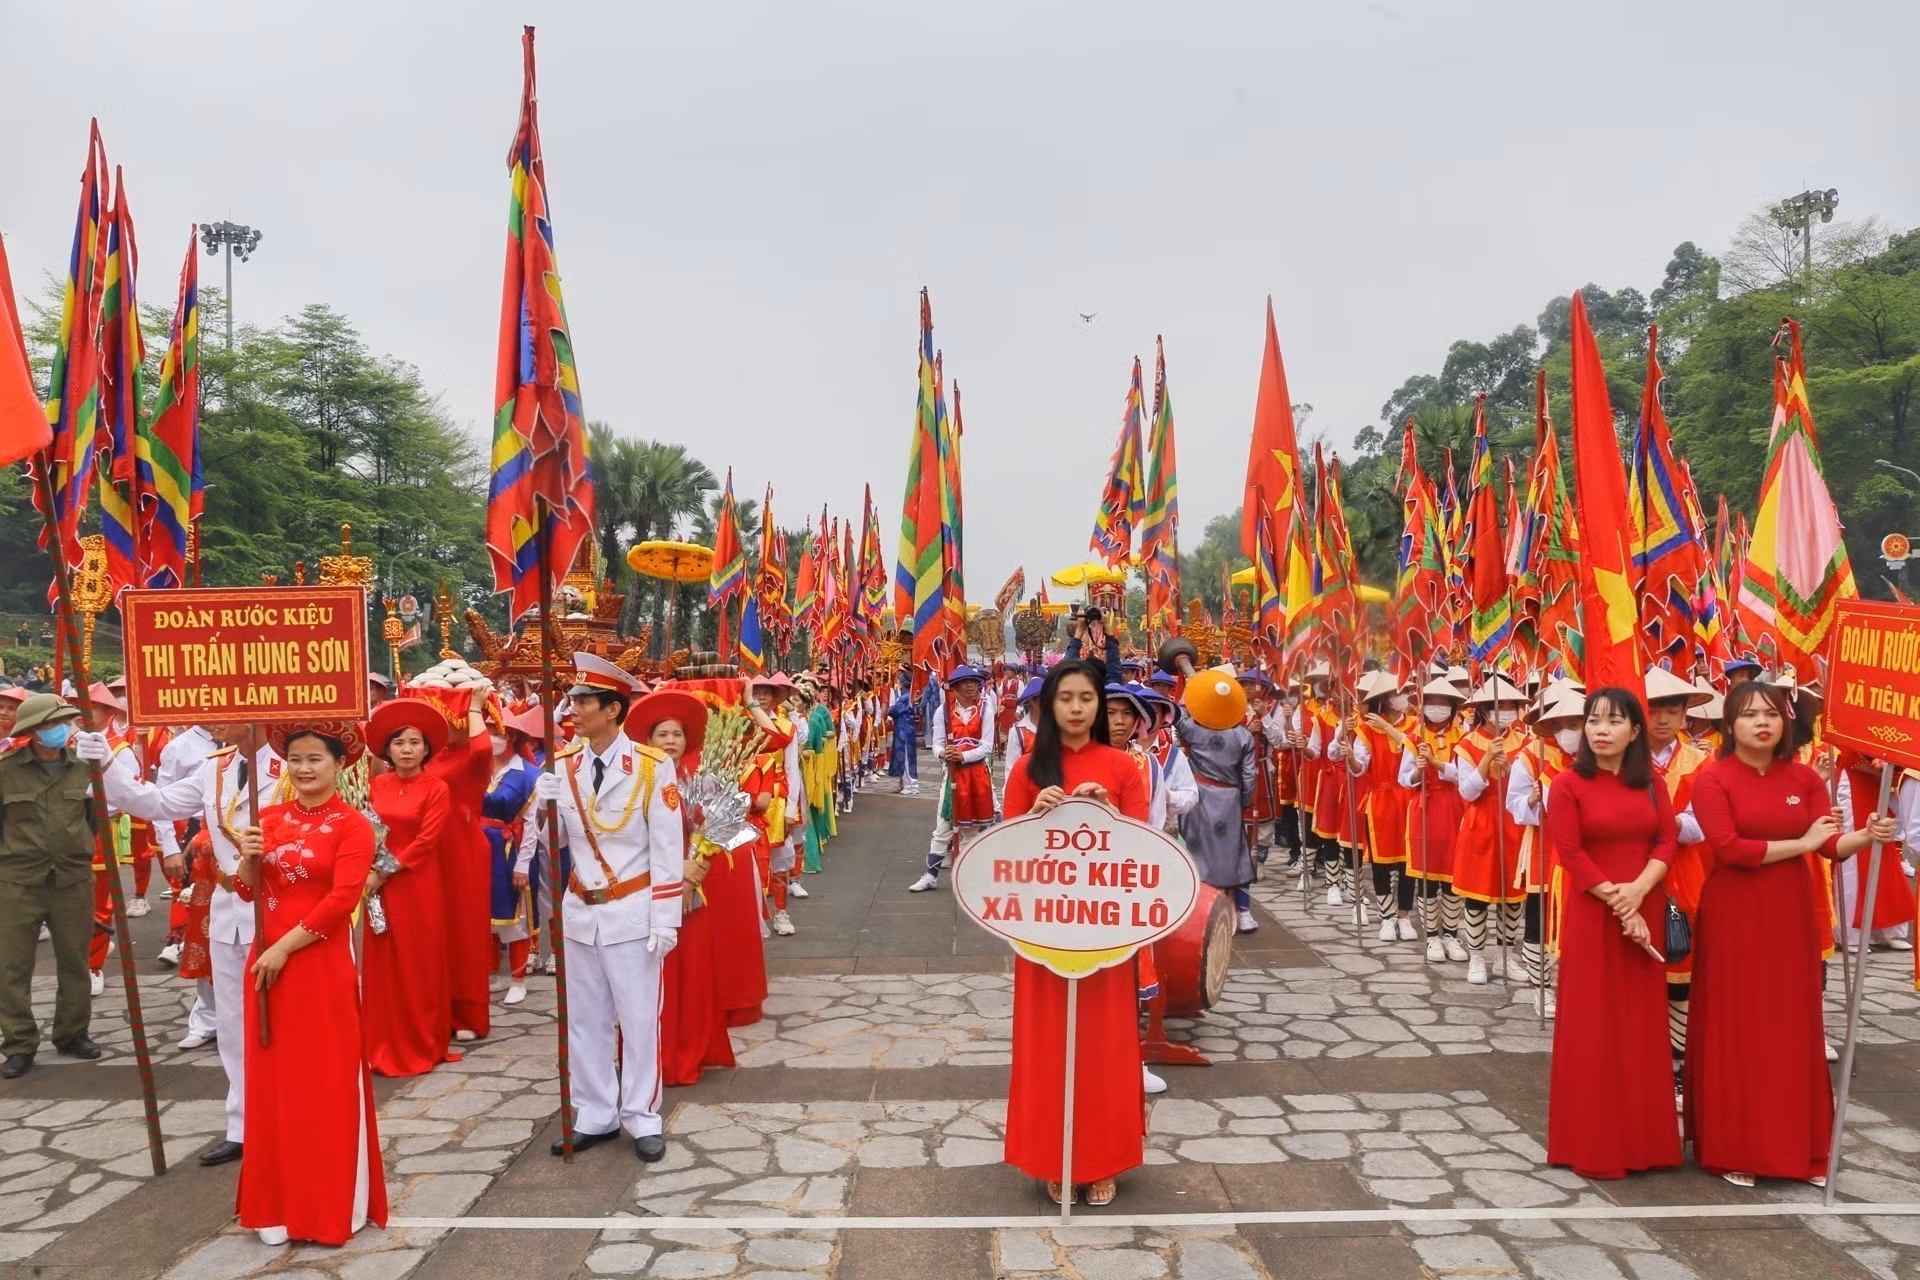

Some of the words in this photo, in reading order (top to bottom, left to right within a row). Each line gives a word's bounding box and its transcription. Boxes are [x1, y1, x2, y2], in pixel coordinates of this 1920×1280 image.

[154, 606, 214, 629] ĐOÀN
[220, 604, 278, 628] RƯỚC
[283, 603, 333, 630] KIỆU
[142, 644, 176, 684] THỊ
[181, 632, 237, 676] TRẤN
[243, 635, 300, 675] HÙNG
[307, 637, 350, 673] SƠN
[1840, 620, 1880, 668] ĐOÀN
[158, 684, 227, 711] HUYỆN
[234, 683, 278, 706] LÂM
[285, 684, 337, 705] THAO
[1844, 679, 1865, 708] XÃ
[1869, 684, 1906, 717] TIÊN
[1045, 823, 1111, 857] ĐỘI
[993, 854, 1077, 885] RƯỚC
[1088, 858, 1160, 893] KIỆU
[982, 892, 1023, 921] XÃ
[1034, 894, 1120, 926] HÙNG
[1131, 898, 1169, 928] LÔ
